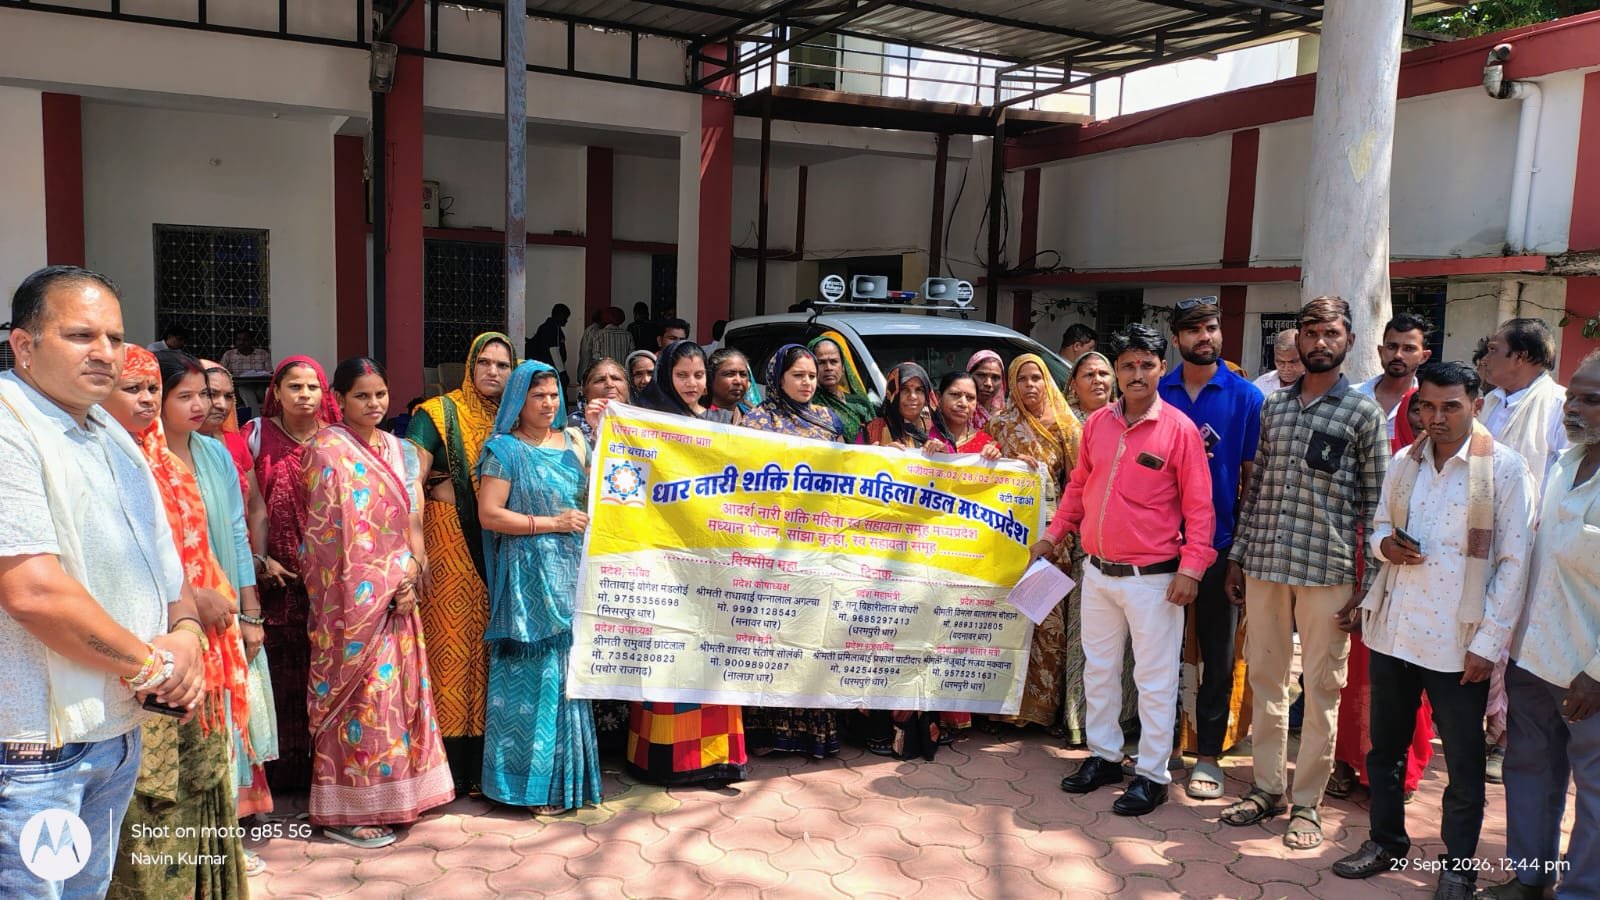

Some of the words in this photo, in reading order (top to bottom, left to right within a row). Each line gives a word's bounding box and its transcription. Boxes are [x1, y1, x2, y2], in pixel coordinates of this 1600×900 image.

[661, 431, 693, 444] मान्यता
[609, 442, 625, 455] बेटी
[627, 446, 658, 460] बचाओ
[652, 480, 690, 504] धार
[695, 464, 738, 497] नारी
[742, 464, 789, 493] शक्ति
[793, 464, 855, 495] विकास
[859, 472, 917, 505] महिला
[920, 480, 956, 514] मंडल
[958, 499, 1030, 545] मध्यप्रदेश
[722, 502, 755, 517] आदर्श
[758, 505, 781, 520] नारी
[784, 508, 810, 523] शक्ति
[812, 511, 843, 528] महिला
[864, 519, 902, 534] सहायता
[905, 523, 930, 538] समूह
[933, 525, 978, 539] मध्यप्रदेश
[708, 519, 744, 534] मध्यान
[748, 522, 782, 542] भोजन,
[787, 527, 815, 543] सांझा
[852, 535, 866, 547] स्व
[869, 537, 908, 551] सहायता
[910, 541, 937, 558] समूह
[731, 552, 774, 570] दिवसीय
[599, 577, 634, 592] सीताबाई
[661, 583, 689, 596] मंडलोई
[732, 578, 752, 589] प्रदेश
[597, 593, 610, 603] मो.
[614, 594, 679, 607] 9755356698
[696, 585, 722, 599] श्रीमती
[757, 594, 792, 605] पन्नालाल
[597, 604, 635, 620] (निसरपुर
[638, 608, 655, 619] धार)
[717, 602, 729, 612] मो.
[733, 604, 797, 617] 9993128543
[859, 599, 897, 613] बिहारीलाल
[933, 605, 953, 617] श्रीमती
[731, 616, 762, 628] (मनावर
[763, 619, 781, 631] धार)
[838, 613, 849, 622] मो.
[852, 614, 910, 626] 9685297413
[594, 623, 615, 634] प्रदेश
[848, 625, 881, 638] (धरमपुरी
[882, 627, 898, 638] धार)
[593, 634, 620, 648] श्रीमती
[592, 648, 604, 660] मो.
[608, 651, 675, 663] 7354280823
[700, 641, 725, 653] श्रीमती
[727, 645, 750, 656] शारदा
[776, 648, 803, 660] सोलंकी
[710, 656, 721, 666] मो.
[724, 658, 789, 671] 9009890287
[723, 669, 754, 682] (नालछा
[756, 673, 774, 684] धार)
[944, 669, 997, 680] 9575251631
